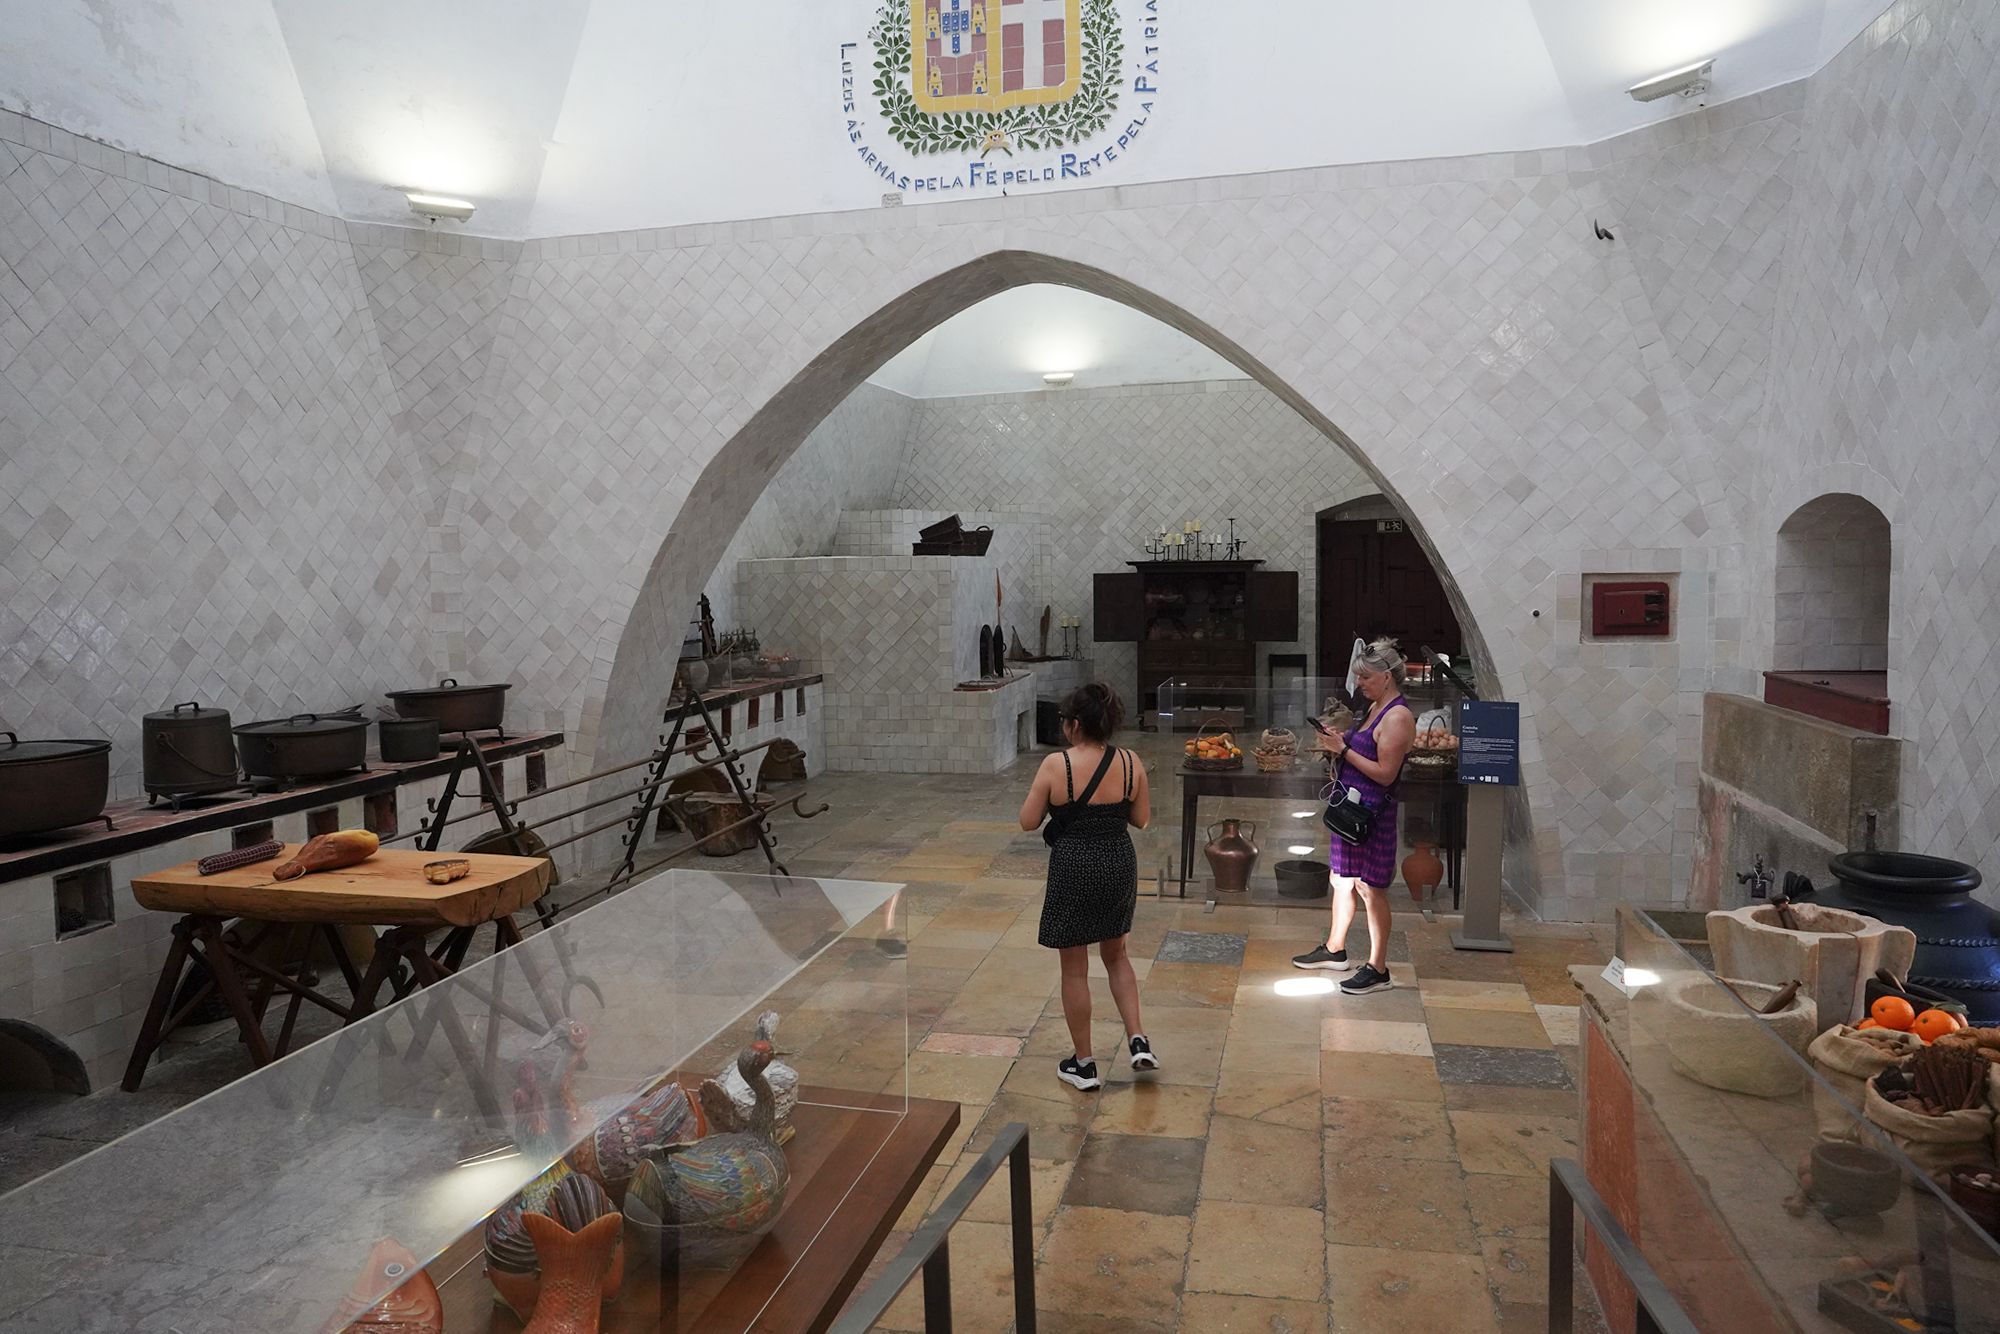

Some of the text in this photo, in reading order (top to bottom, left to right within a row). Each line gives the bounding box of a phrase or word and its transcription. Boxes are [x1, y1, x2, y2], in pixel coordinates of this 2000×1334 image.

[858, 146, 910, 189] ARMAS
[915, 176, 963, 191] PELA
[970, 162, 997, 187] FÉ
[1003, 168, 1054, 184] PELO
[1061, 153, 1100, 177] REY
[1104, 146, 1118, 162] E
[1117, 101, 1154, 149] PELA
